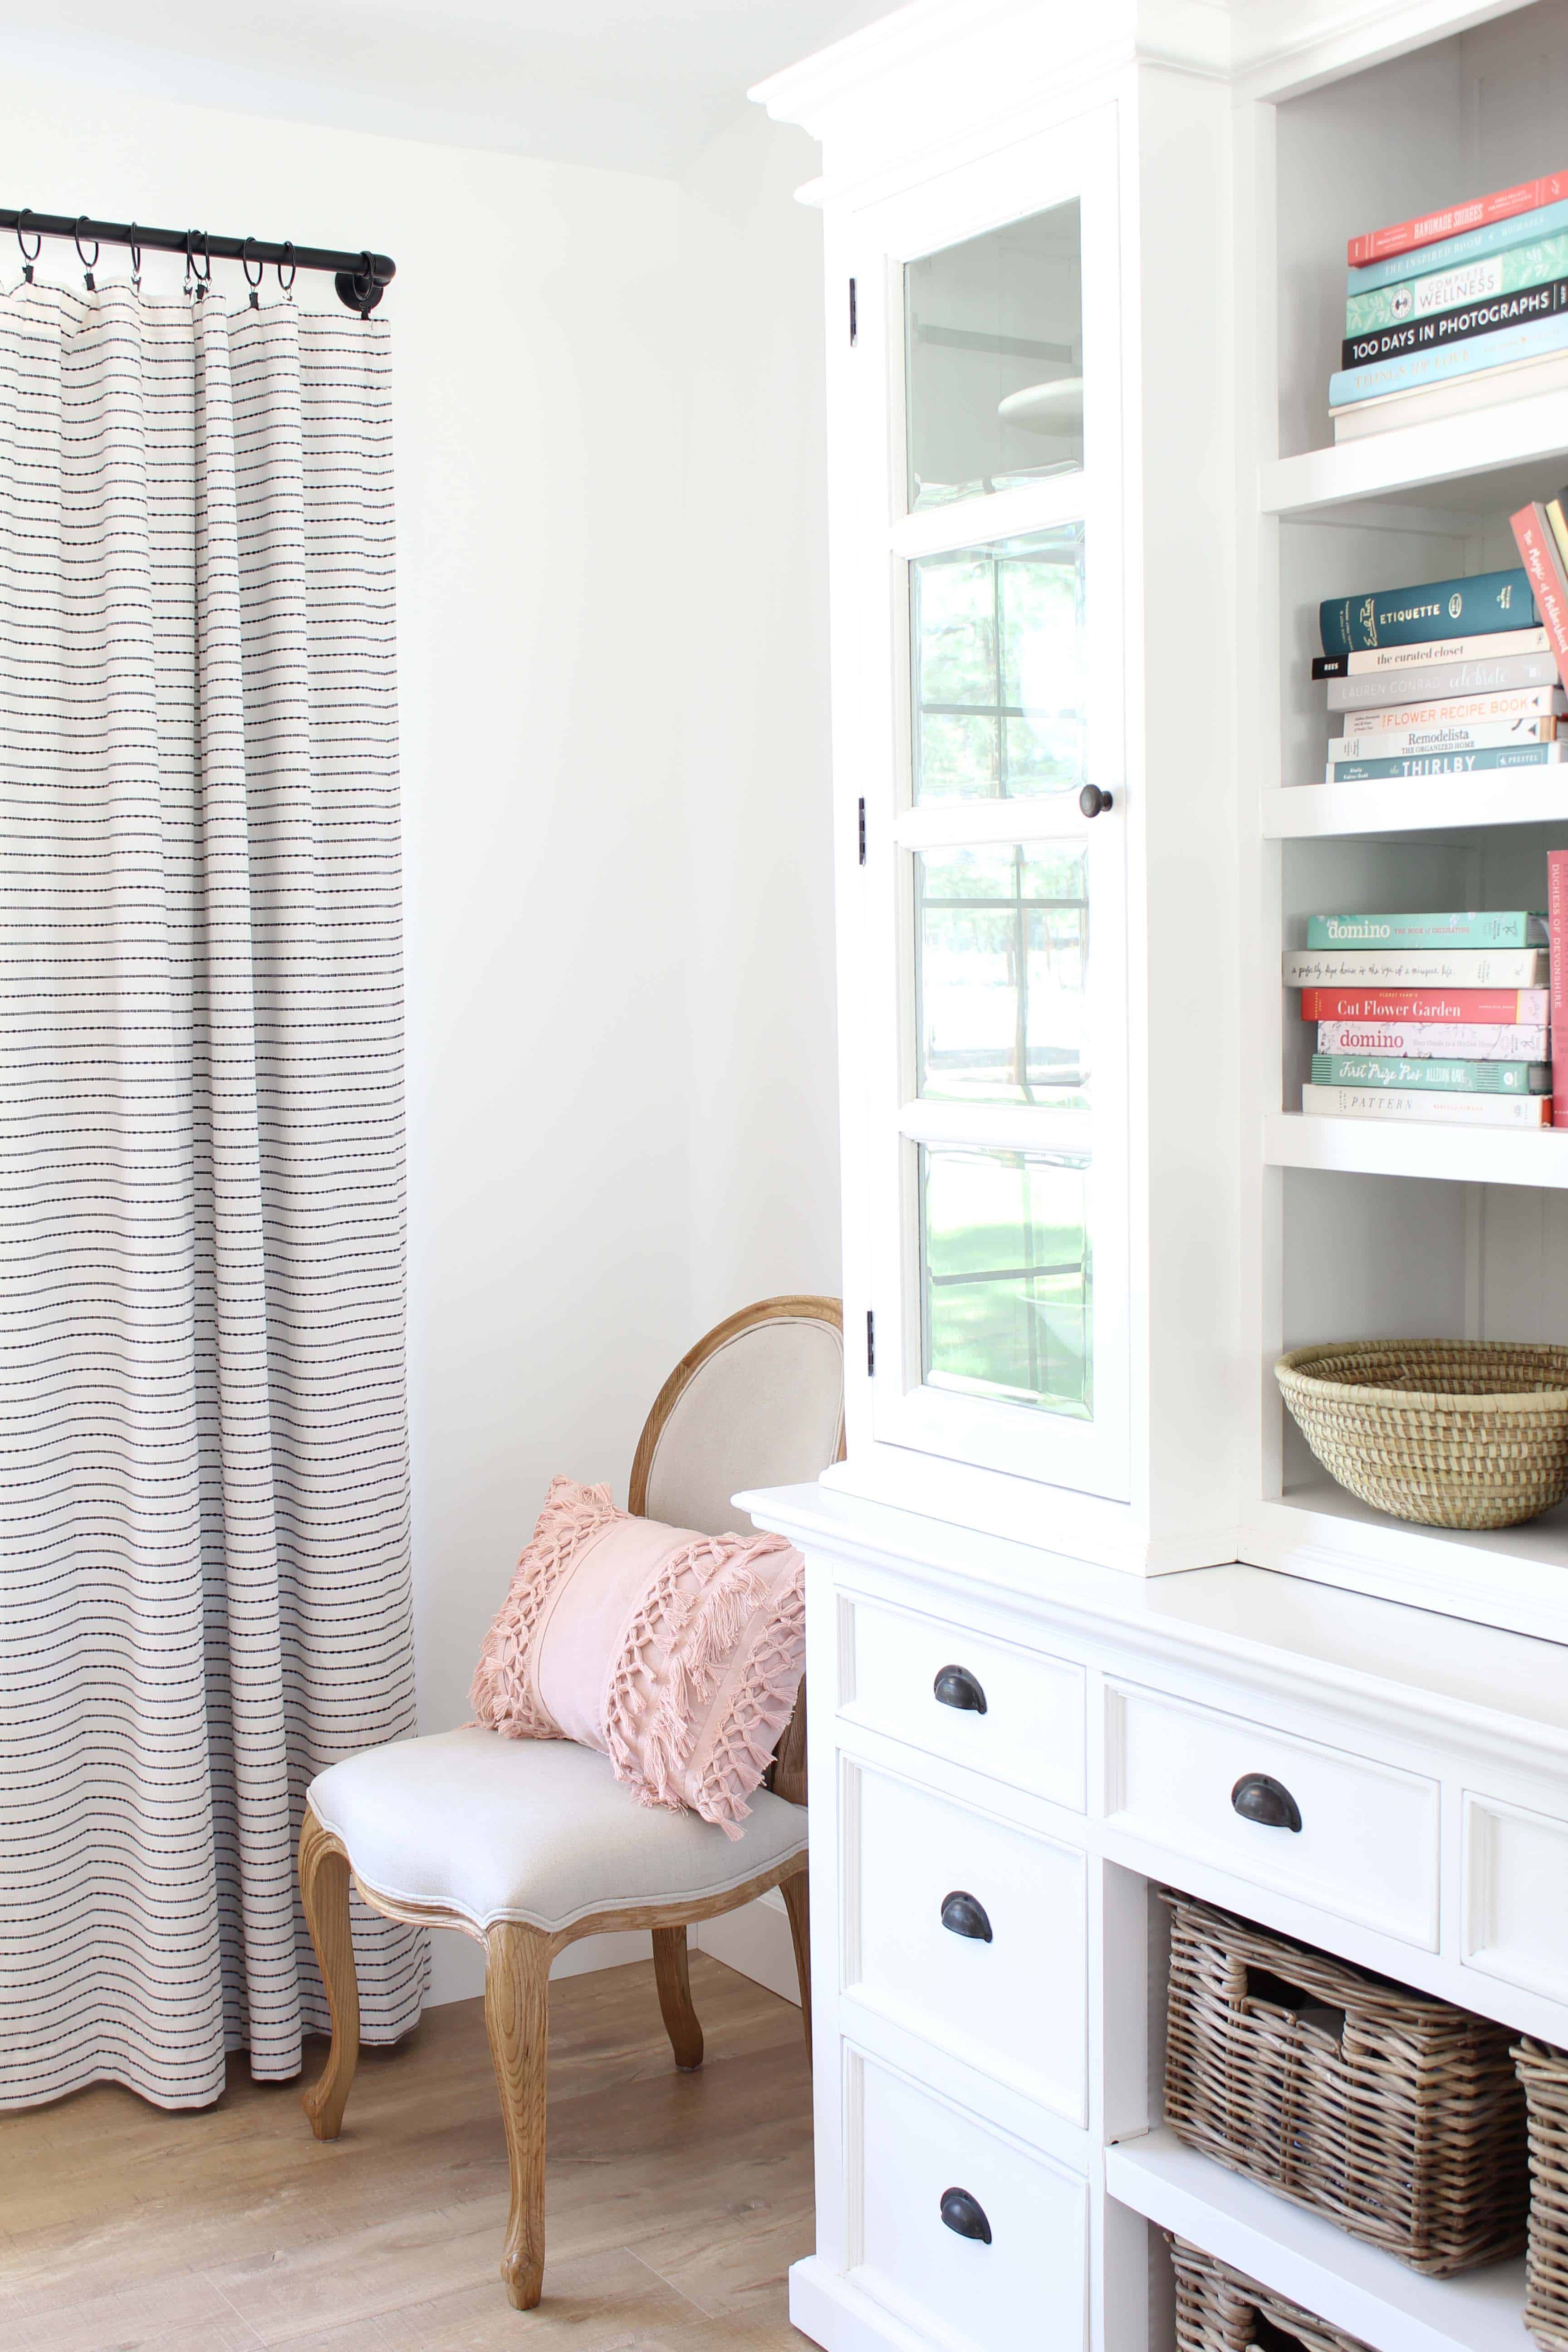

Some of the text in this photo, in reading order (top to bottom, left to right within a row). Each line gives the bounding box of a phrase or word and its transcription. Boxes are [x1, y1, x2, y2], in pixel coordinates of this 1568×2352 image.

[1414, 214, 1452, 240] HANDMADE
[1385, 236, 1482, 275] THE INSPIRED ROOM
[1427, 267, 1485, 291] COMPLETE
[1419, 274, 1494, 309] WELLNESS
[1352, 339, 1378, 359] 100
[1381, 328, 1415, 352] DAYS
[1419, 323, 1435, 342] IN
[1439, 291, 1550, 336] PHOTOGRAPHS
[1354, 364, 1406, 388] THINGS
[1434, 348, 1468, 368] LOVE
[1523, 529, 1568, 654] The Magic of Motherhood
[1380, 604, 1441, 624] ETIQUETTE
[1377, 646, 1464, 665] the curated closet
[1342, 684, 1387, 699] LAUREN
[1389, 677, 1440, 694] CONRAD
[1387, 712, 1436, 726] FLOWER
[1440, 703, 1485, 720] RECIPE
[1490, 698, 1528, 713] BOOK
[1408, 729, 1469, 745] Remodelista
[1416, 743, 1453, 753] ORGANIZED
[1455, 740, 1475, 750] HOME
[1402, 755, 1476, 776] THIRLBY
[1508, 755, 1539, 764] PRESTEL
[1328, 920, 1391, 939] domino
[1552, 863, 1562, 1009] DUCHESS OF DEVONSHIRE
[1337, 1000, 1360, 1015] Cut
[1364, 1000, 1409, 1016] Flower
[1412, 1001, 1461, 1017] Garden
[1340, 1029, 1404, 1048] domino
[1339, 1061, 1423, 1085] First Prize Pies
[1351, 1096, 1413, 1110] PATTERN
